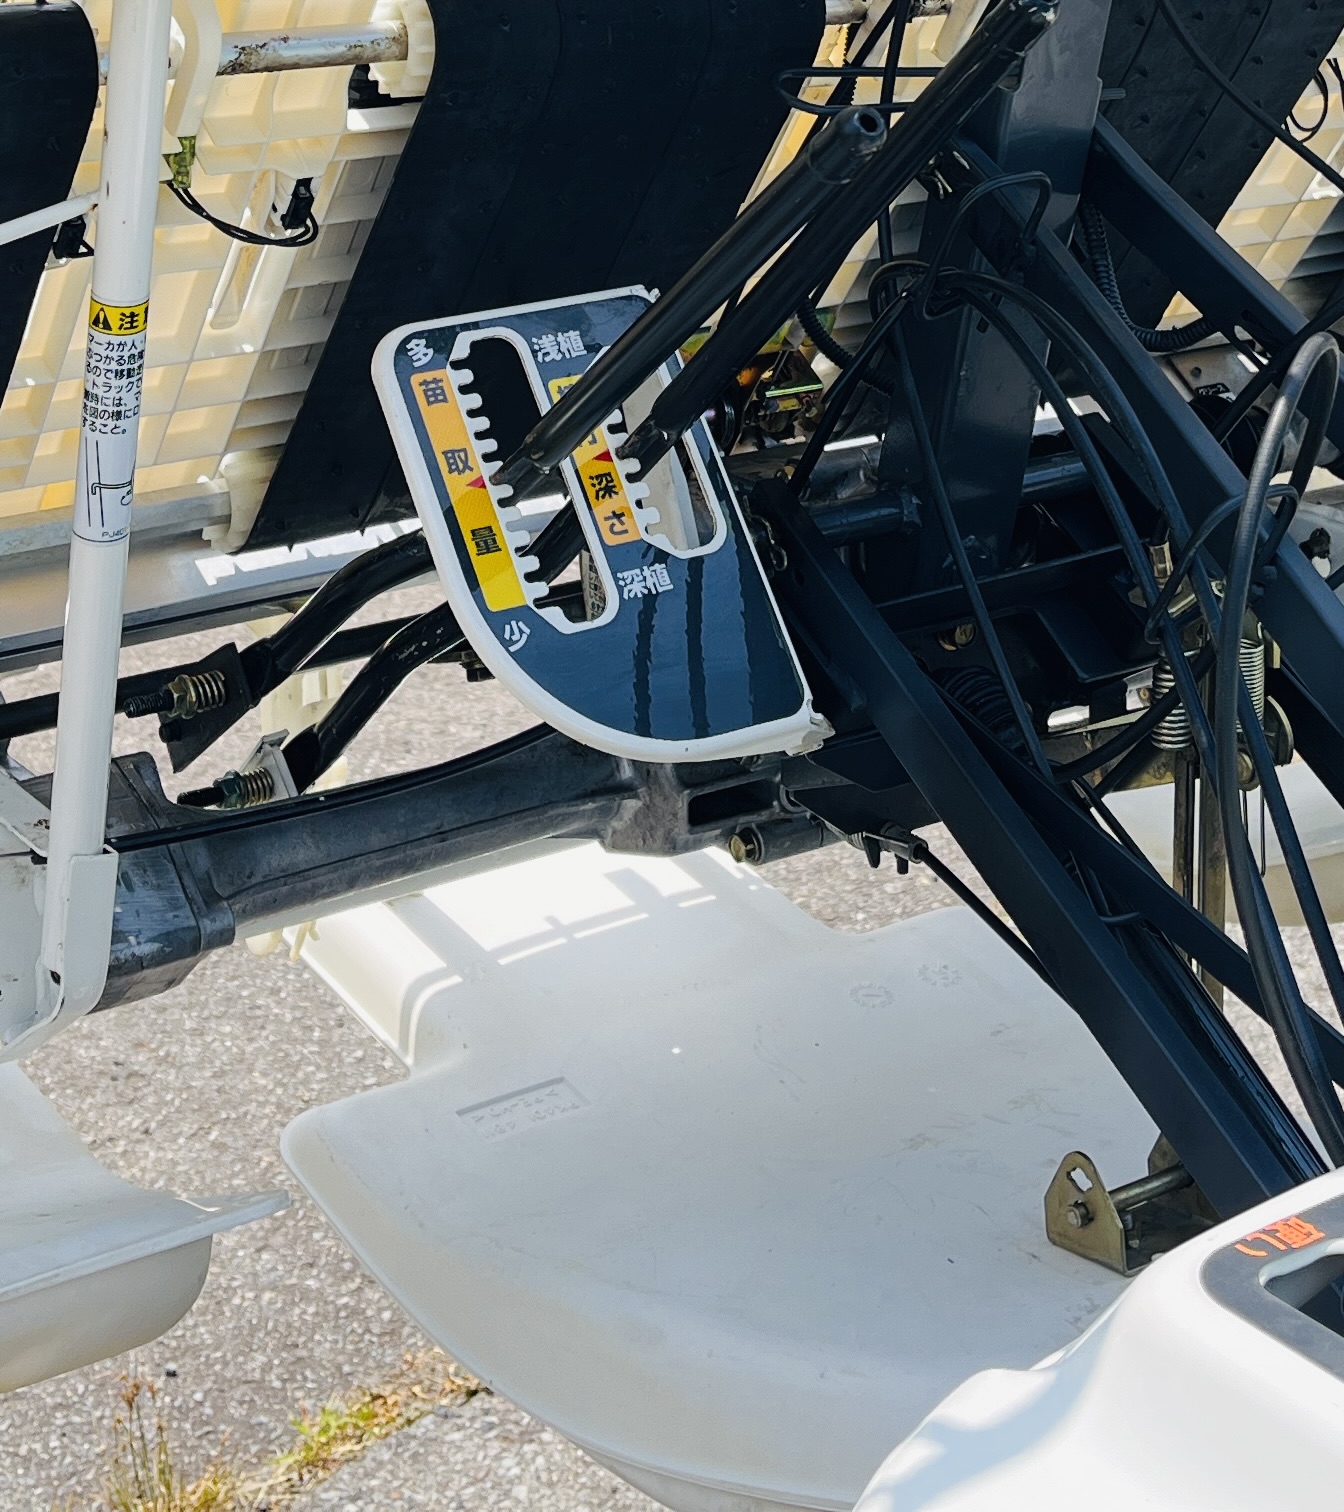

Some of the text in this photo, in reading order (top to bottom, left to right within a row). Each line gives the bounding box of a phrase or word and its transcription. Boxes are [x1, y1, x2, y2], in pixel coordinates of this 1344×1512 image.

[118, 305, 148, 331] 注
[406, 338, 434, 368] 多
[531, 329, 588, 363] 浅植
[616, 562, 675, 601] 深植
[504, 620, 531, 652] 少
